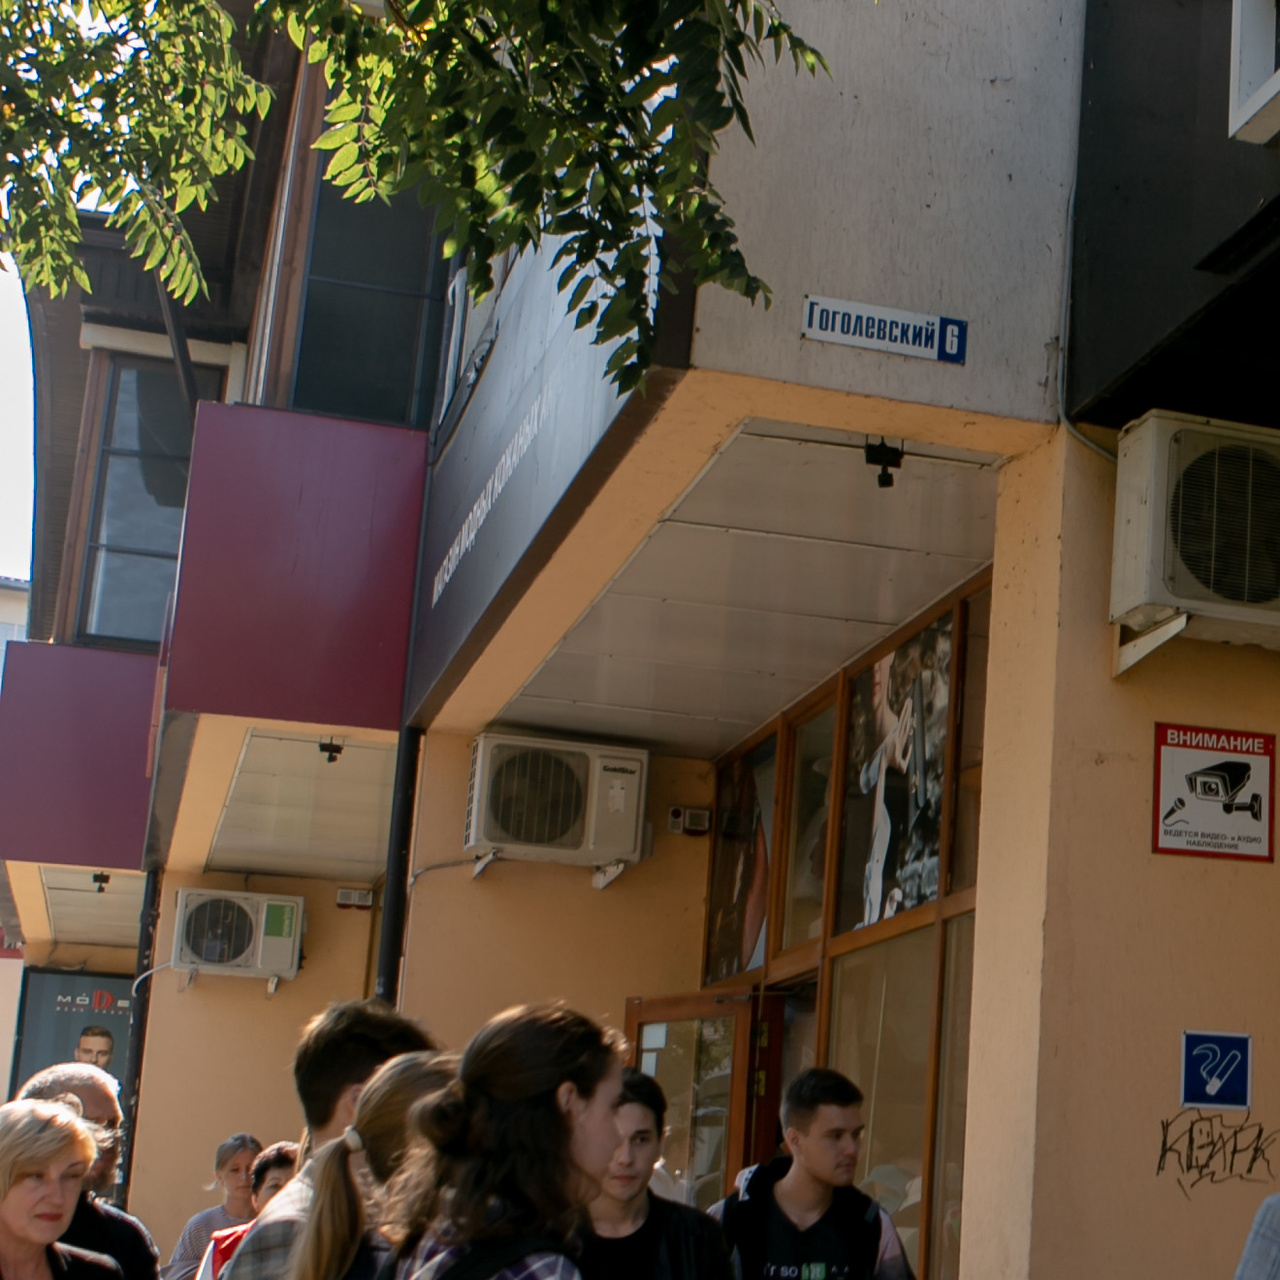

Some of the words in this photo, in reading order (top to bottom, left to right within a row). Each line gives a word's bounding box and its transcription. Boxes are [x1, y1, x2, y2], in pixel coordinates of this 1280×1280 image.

[807, 301, 936, 350] Гоголевский
[945, 324, 960, 355] 6
[1166, 729, 1265, 753] ВНИМАНИЕ
[1163, 828, 1199, 838] ВЕДЕТСЯ
[1237, 835, 1262, 844] АУДИО
[1186, 839, 1240, 850] НАБЛЮДЕНИЕ
